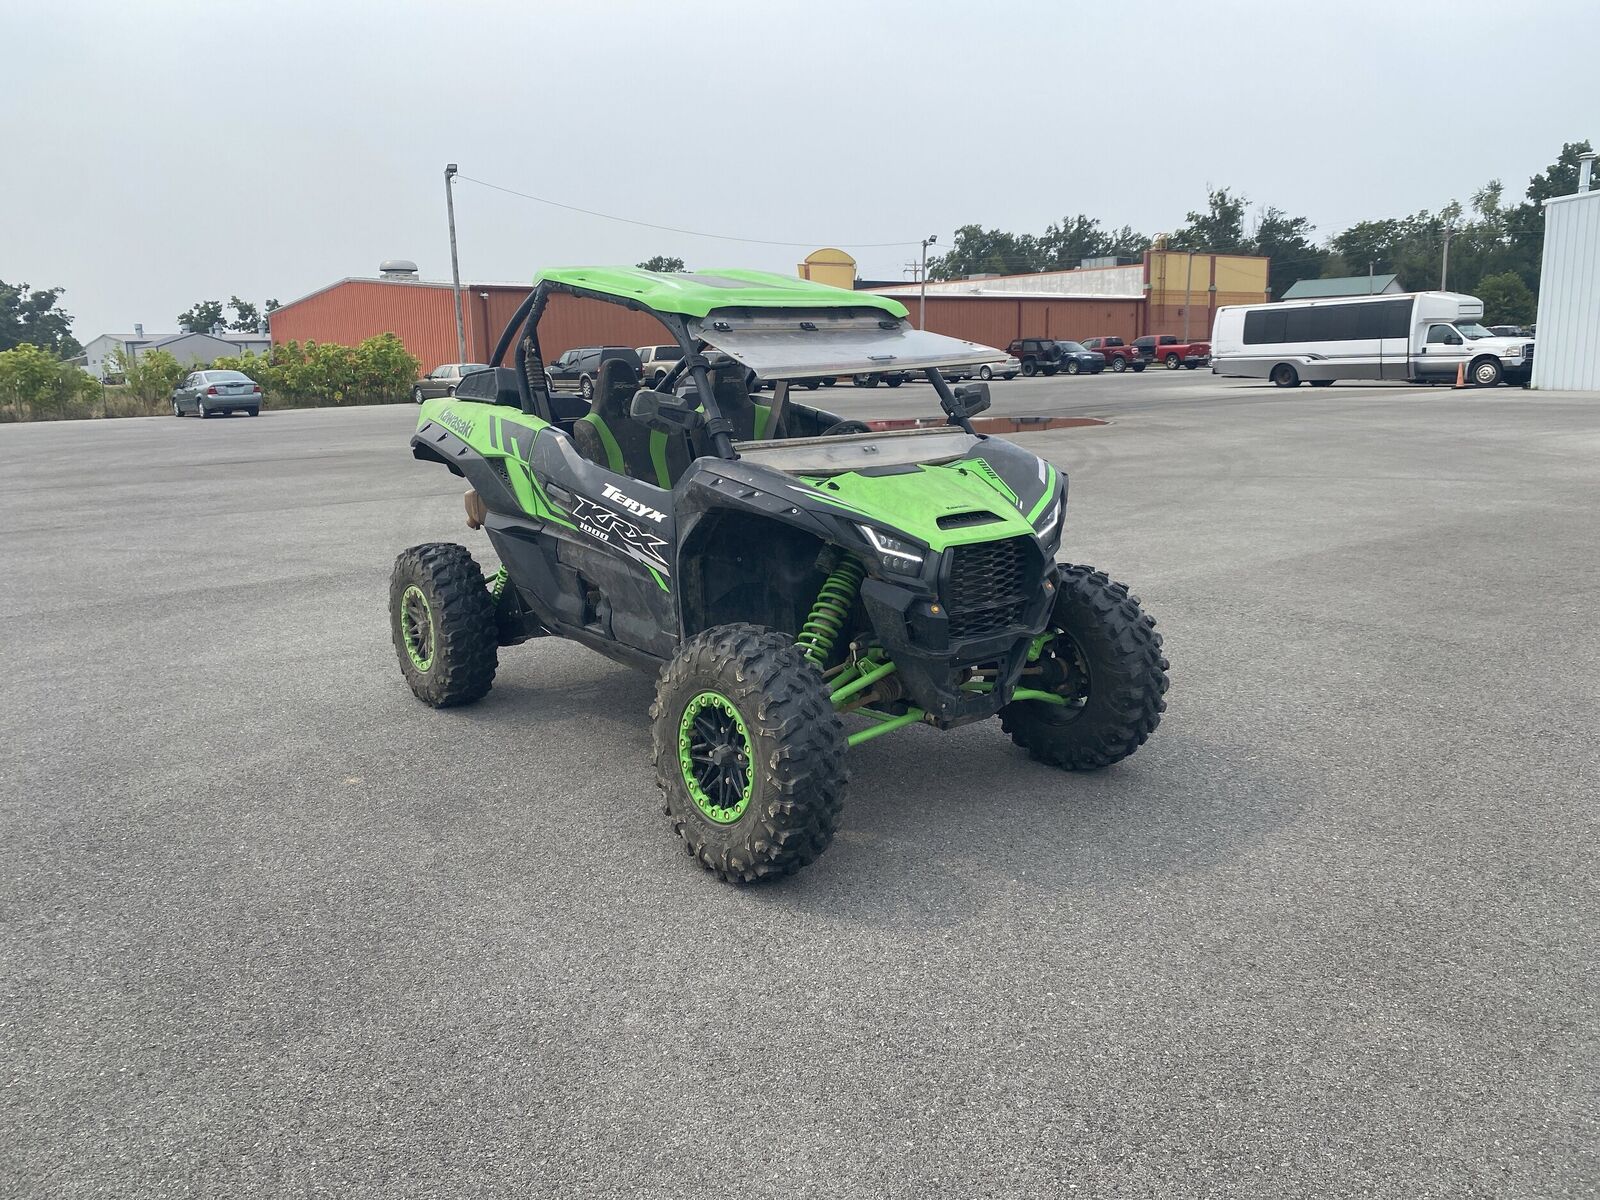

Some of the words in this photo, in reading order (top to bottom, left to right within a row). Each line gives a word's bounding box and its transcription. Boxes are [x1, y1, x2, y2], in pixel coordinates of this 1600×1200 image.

[438, 406, 476, 439] Kawasaki
[572, 494, 670, 566] KRX
[579, 521, 610, 541] 1000
